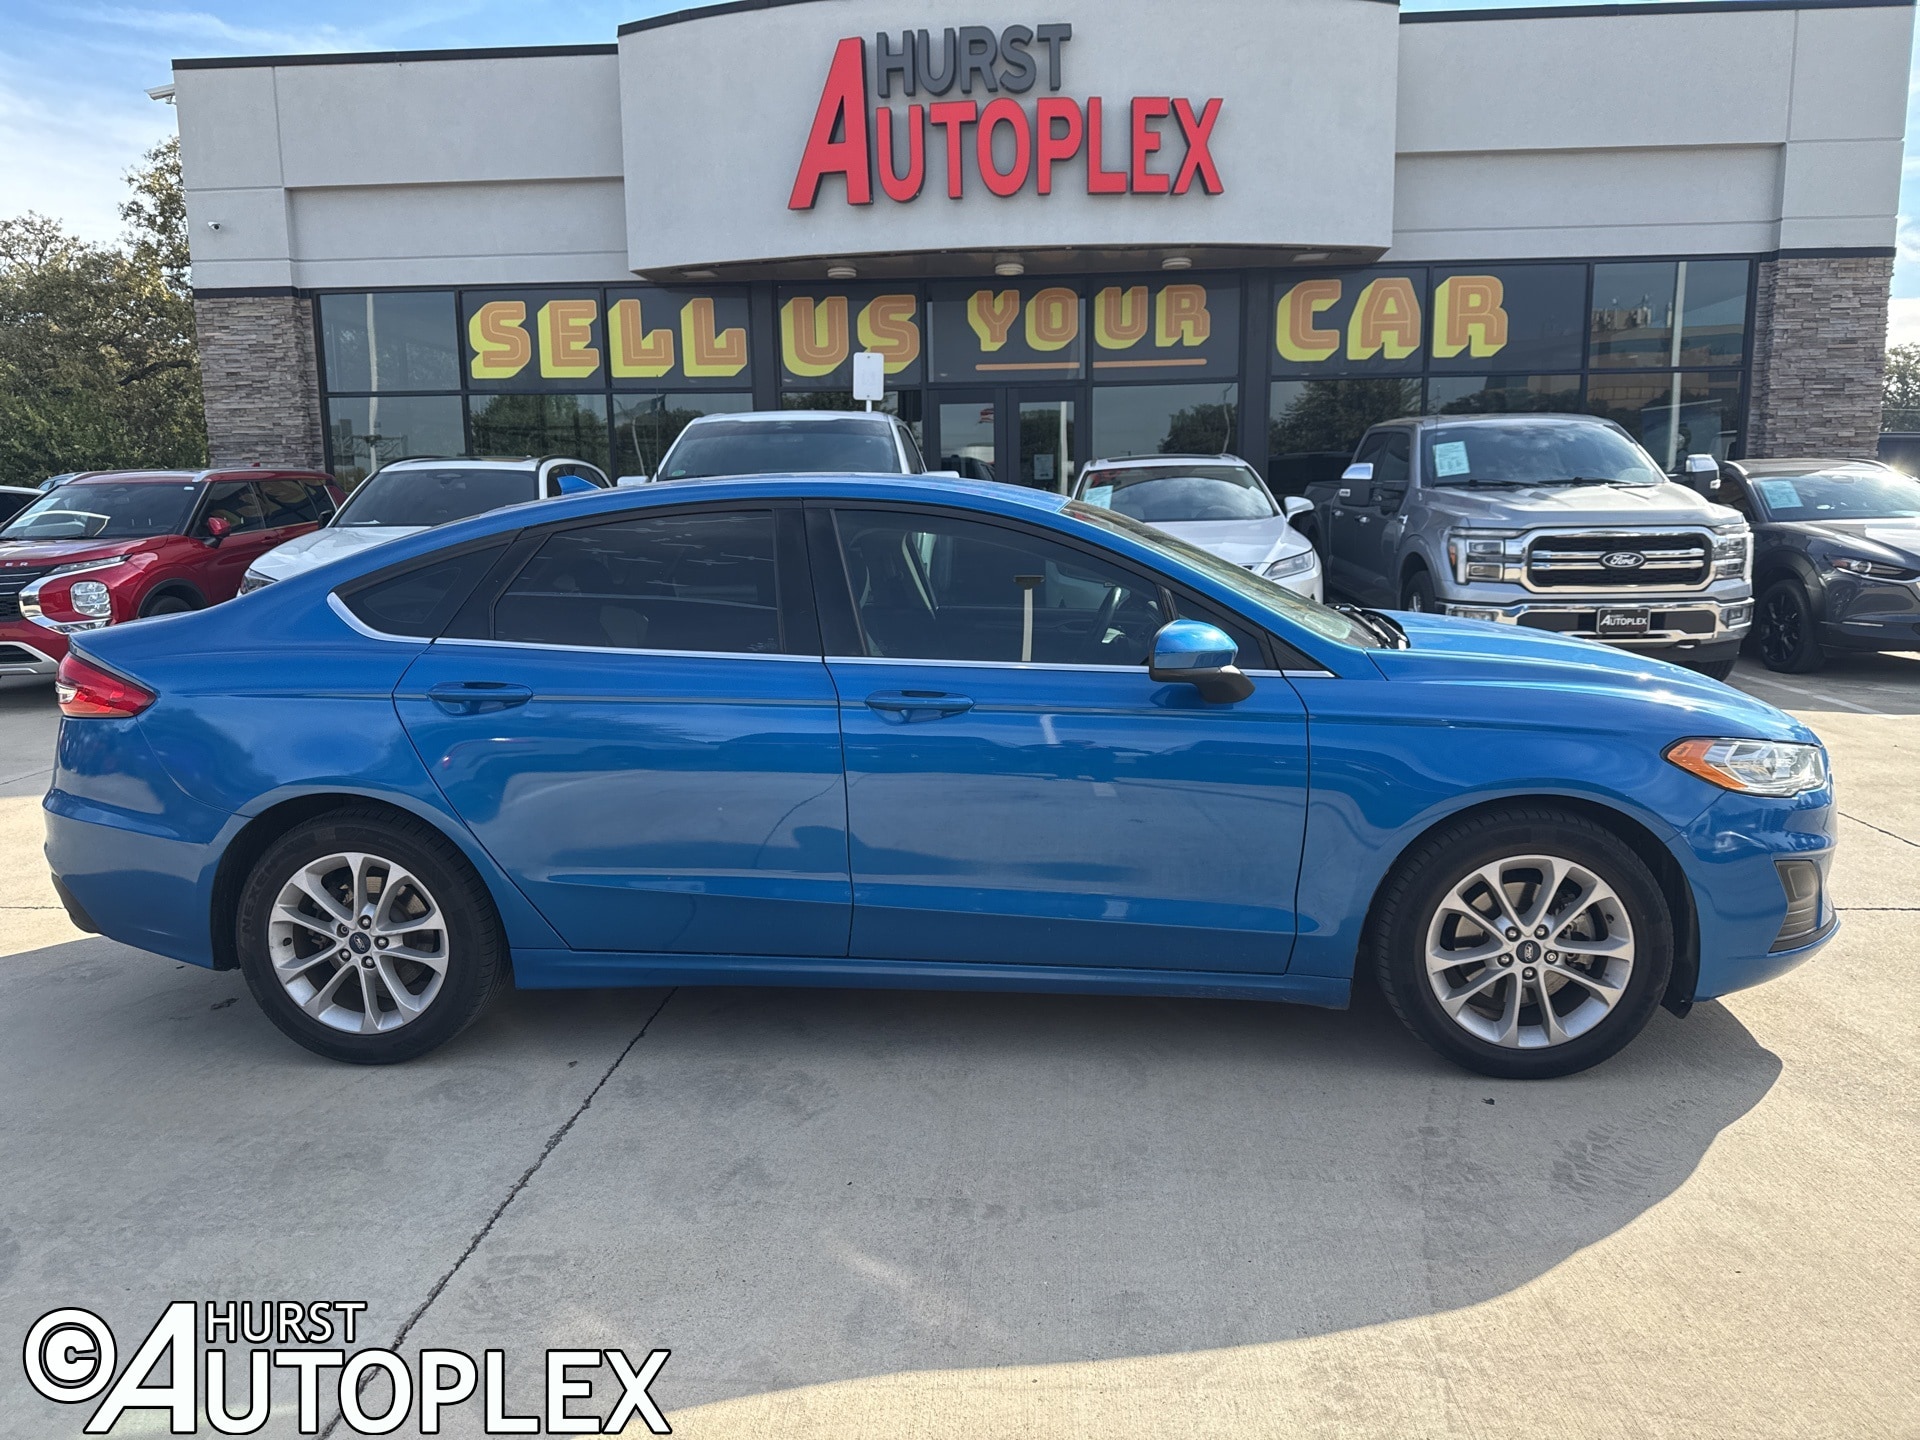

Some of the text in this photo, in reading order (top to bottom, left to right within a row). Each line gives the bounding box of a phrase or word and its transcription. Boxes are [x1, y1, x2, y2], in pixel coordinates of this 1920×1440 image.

[876, 23, 1072, 98] HURST
[788, 37, 1224, 210] AUTOPLEX
[468, 275, 1509, 379] SELL US YOUR CAR
[1610, 554, 1637, 565] Ford
[1600, 614, 1648, 626] AUTOPLEX
